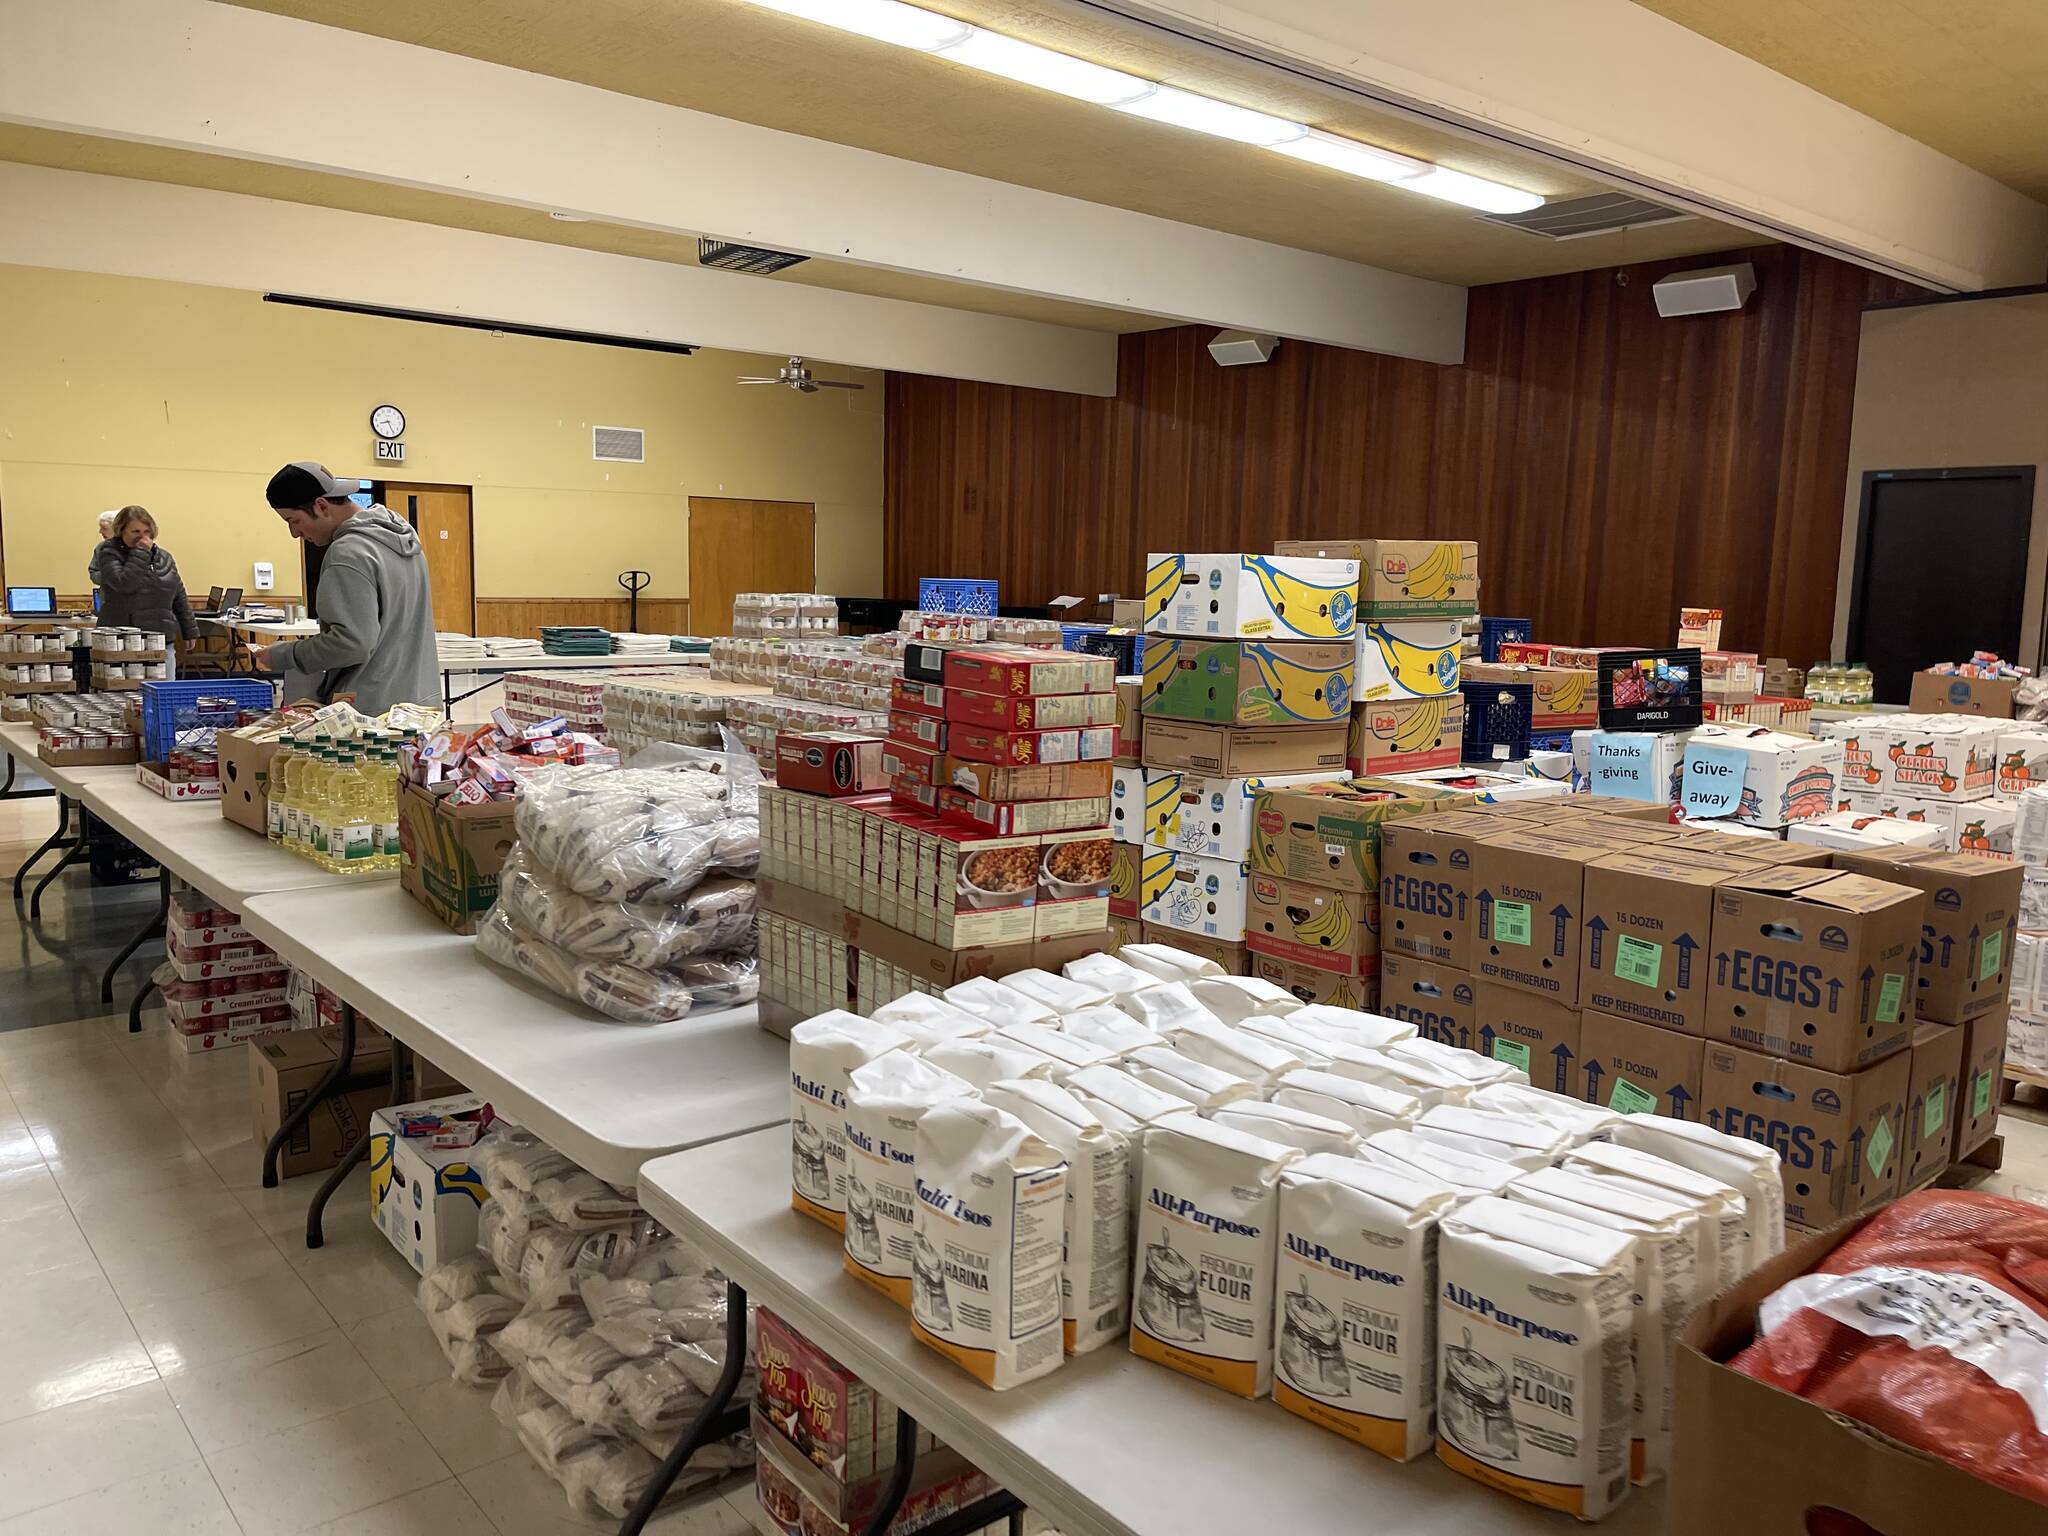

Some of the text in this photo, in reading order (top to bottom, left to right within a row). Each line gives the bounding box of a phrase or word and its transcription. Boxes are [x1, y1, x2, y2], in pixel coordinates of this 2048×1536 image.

[378, 441, 405, 459] EXIT
[1386, 559, 1406, 571] Dole
[1375, 715, 1395, 728] Dole
[1636, 711, 1669, 721] DARIGOLD
[1598, 745, 1641, 757] Thanks
[1598, 766, 1639, 780] -giving
[1692, 760, 1733, 777] Give-
[1897, 757, 1947, 771] CITRUS
[1896, 770, 1944, 785] SHACK
[199, 786, 220, 795] Cream
[1690, 791, 1730, 809] away
[1319, 824, 1353, 837] Premium
[1257, 881, 1277, 895] Dole
[1393, 874, 1453, 918] EGGS
[1501, 884, 1542, 902] 15 DOZEN
[1616, 911, 1664, 931] 15 DOZEN
[1394, 937, 1417, 952] HANDLE
[1435, 945, 1451, 960] CARE
[229, 965, 250, 973] Cream
[253, 961, 263, 971] of
[1480, 962, 1560, 992] KEEP REFRIGERATED
[1731, 949, 1823, 1008] EGGS
[229, 1002, 251, 1010] Cream
[253, 998, 263, 1007] of
[1591, 993, 1685, 1026] KEEP REFRIGERATED
[1503, 1021, 1543, 1040] 15 DOZEN
[1730, 1025, 1813, 1059] HANDLE WITH CARE
[1612, 1056, 1659, 1080] 15 DOZEN
[792, 1072, 846, 1109] Multi Us
[826, 1126, 846, 1146] PREM
[826, 1141, 846, 1162] HARI
[875, 1199, 914, 1224] HARINA
[944, 1242, 989, 1272] PREMIUM
[1200, 1253, 1253, 1281] PREMIUM
[944, 1263, 990, 1292] HARINA
[1200, 1270, 1251, 1301] FLOUR
[1343, 1302, 1399, 1332] PREMIUM
[1343, 1320, 1398, 1355] FLOUR
[760, 1331, 791, 1370] Stove
[768, 1359, 787, 1389] Top
[1512, 1356, 1576, 1396] PREMIUM
[800, 1366, 838, 1408] Stove
[1512, 1376, 1574, 1417] FLOUR
[811, 1400, 832, 1432] Top
